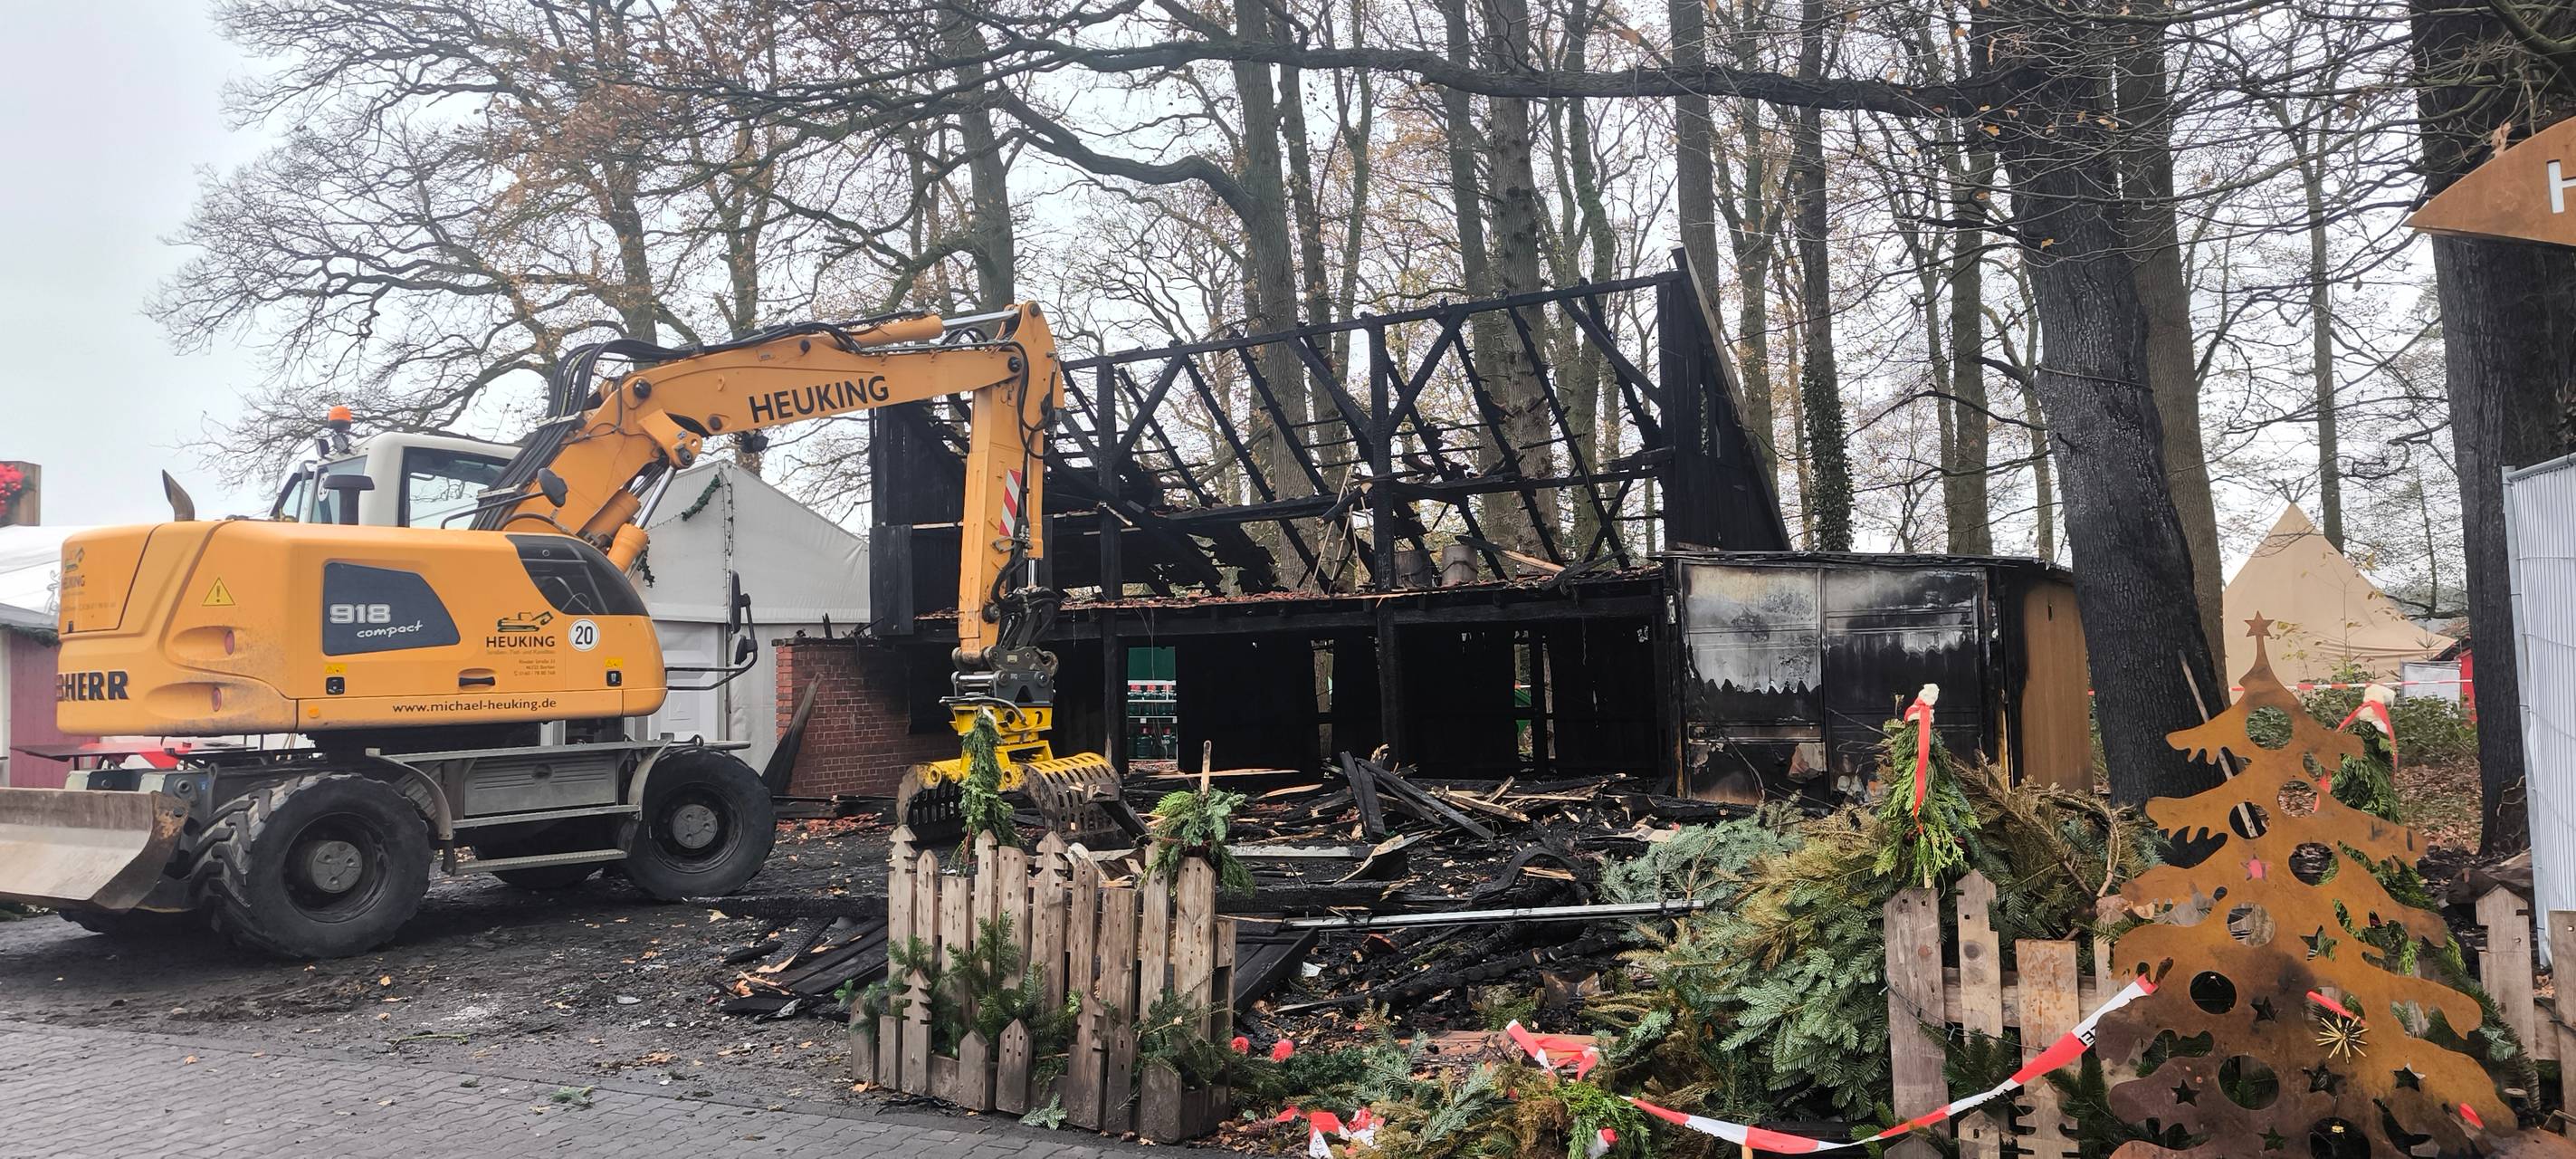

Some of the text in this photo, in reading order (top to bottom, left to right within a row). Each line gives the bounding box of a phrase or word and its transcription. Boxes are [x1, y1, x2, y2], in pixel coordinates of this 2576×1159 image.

[749, 376, 889, 423] HEUKING
[329, 604, 391, 624] 918
[357, 620, 423, 637] compact
[575, 626, 593, 645] 20
[486, 636, 556, 647] HEUKING
[392, 698, 558, 713] www.michael-heuking.de
